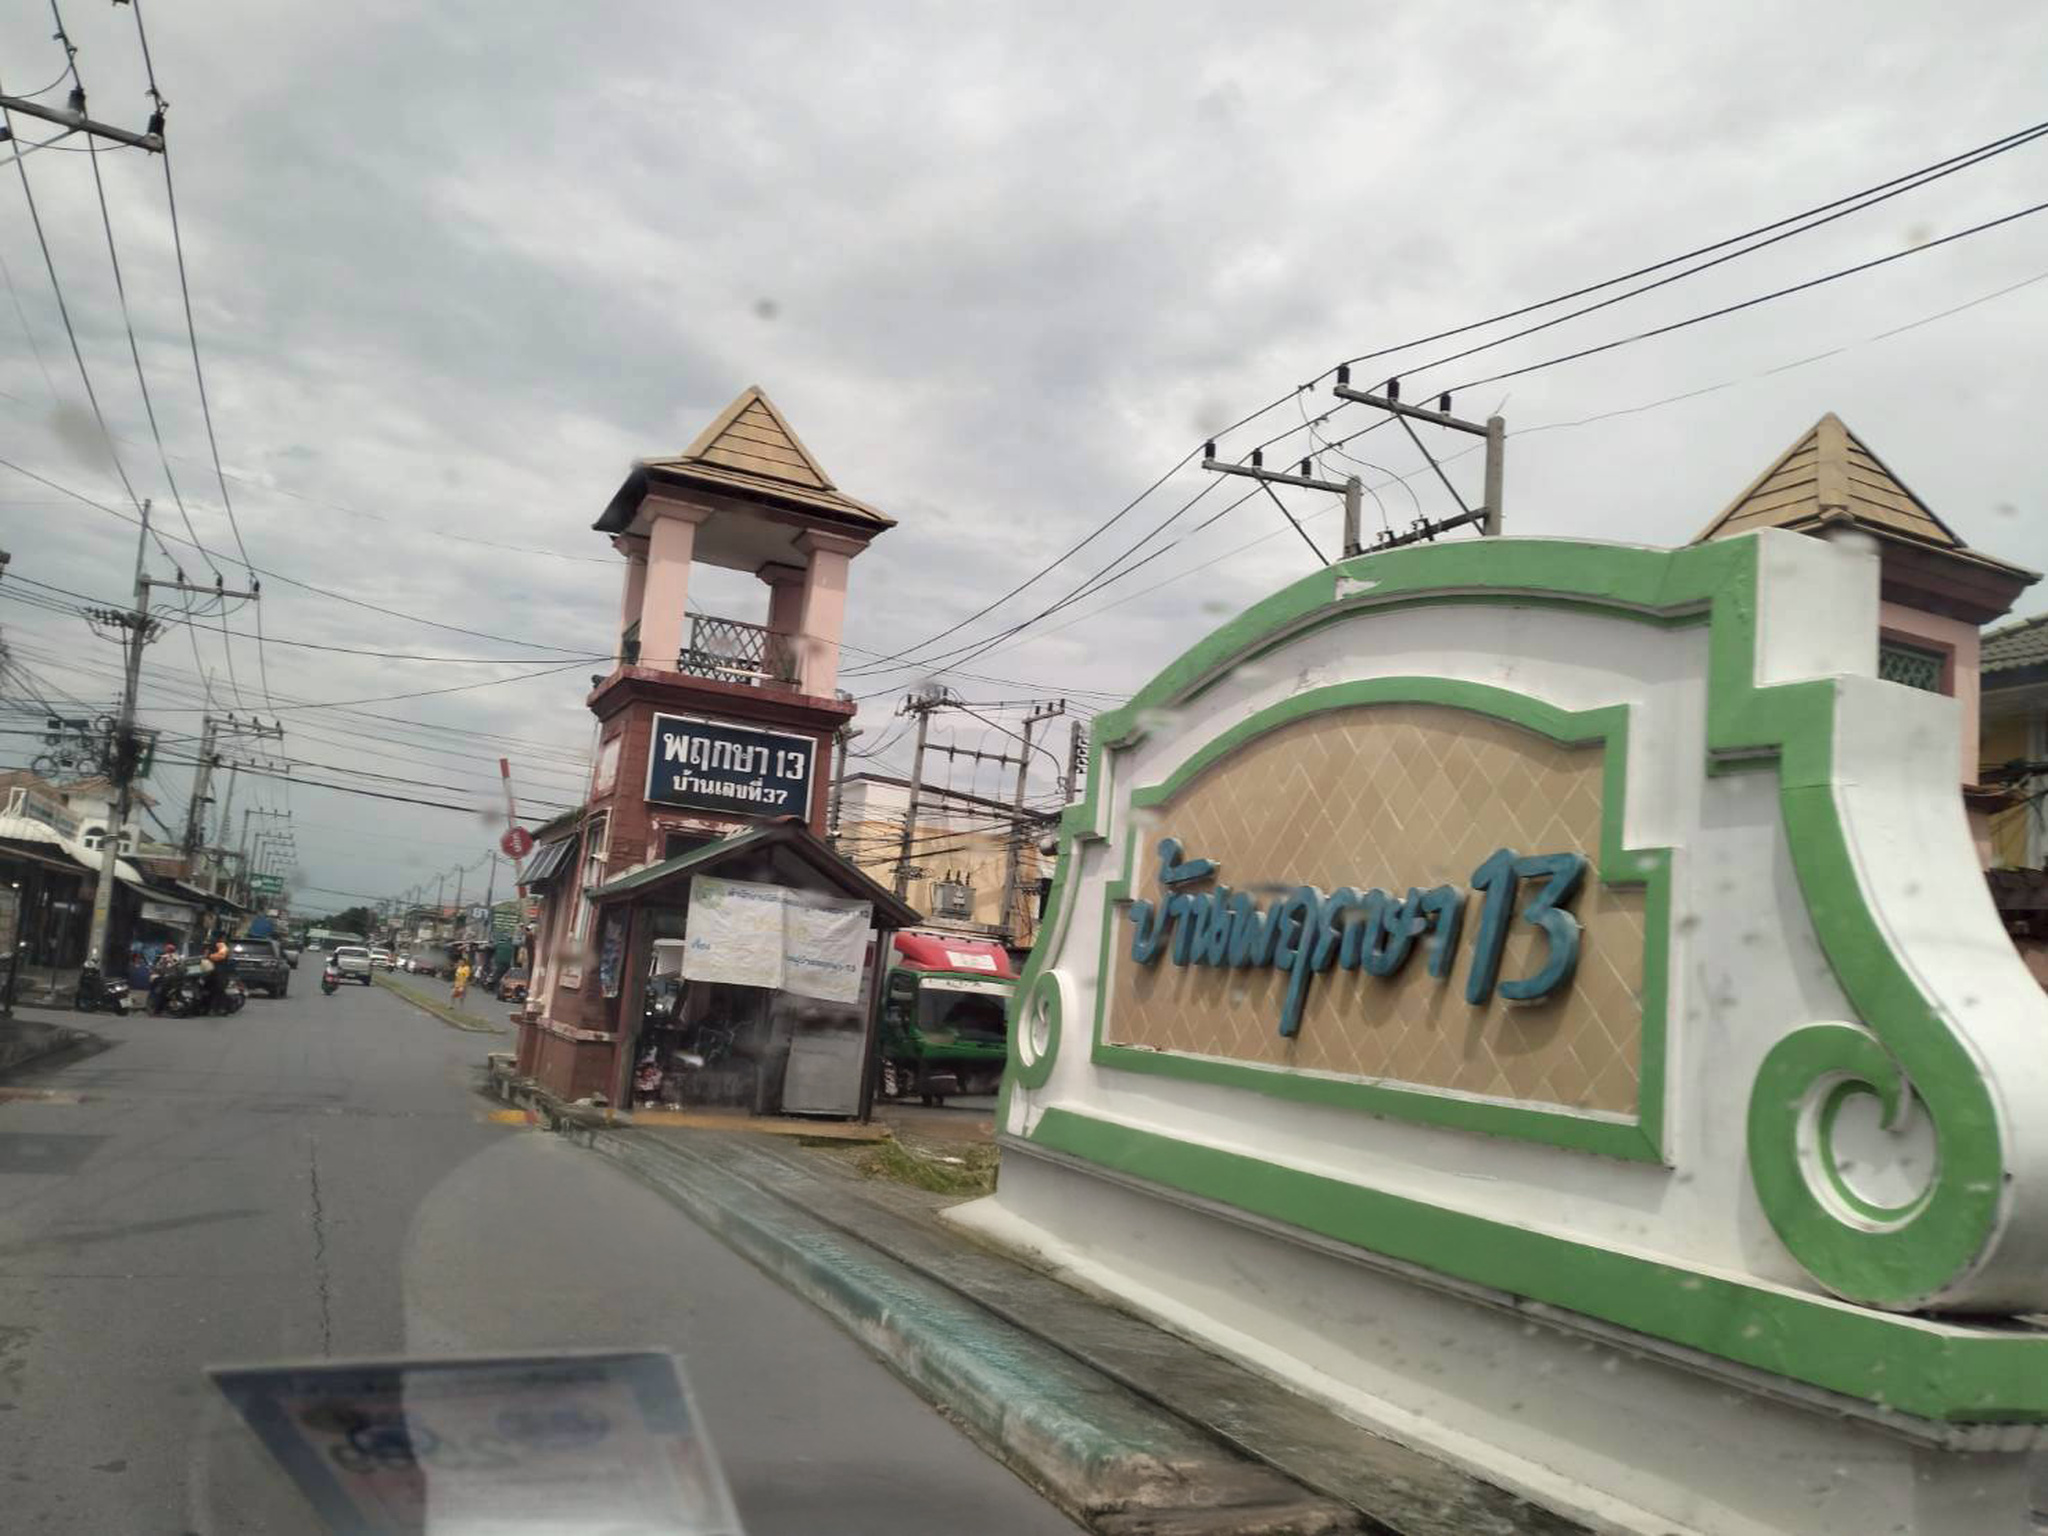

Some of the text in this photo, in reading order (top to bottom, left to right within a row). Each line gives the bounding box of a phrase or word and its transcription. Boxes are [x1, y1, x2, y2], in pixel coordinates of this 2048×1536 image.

[663, 733, 805, 780] พฤกษา 13
[1129, 837, 1588, 1037] บ้านพฤกษา 13
